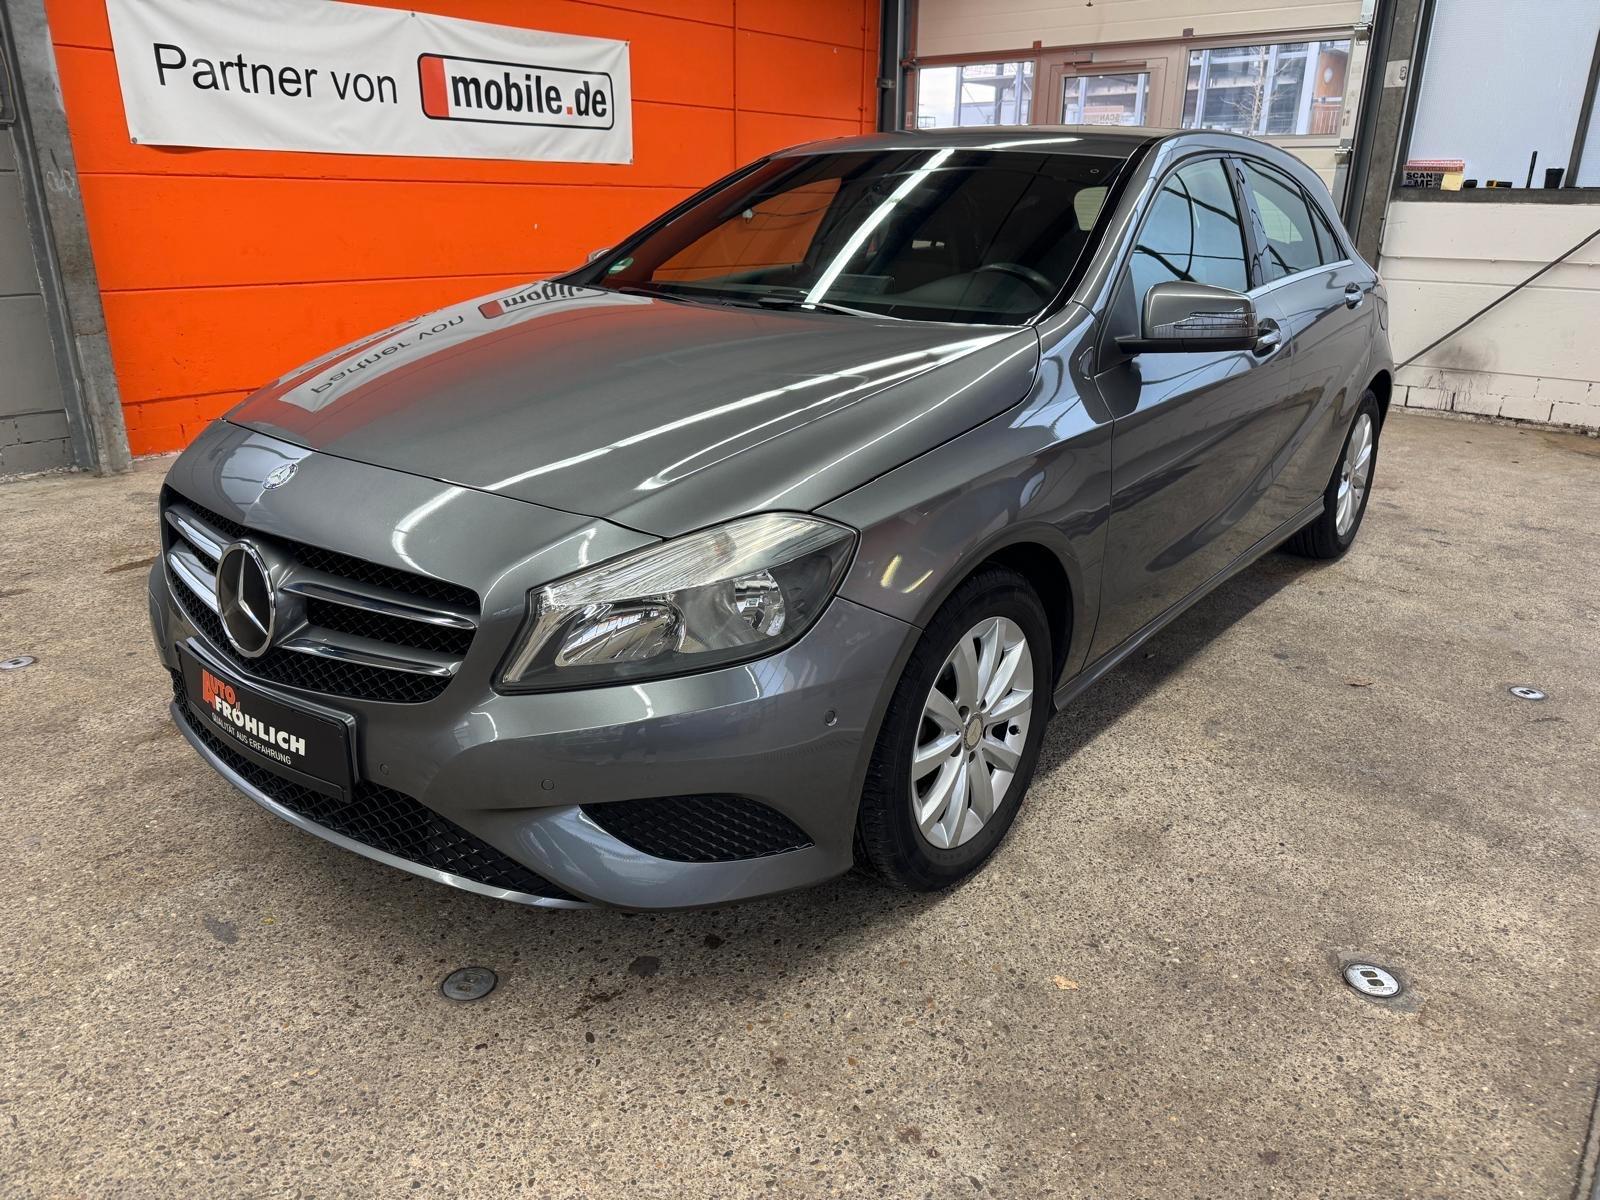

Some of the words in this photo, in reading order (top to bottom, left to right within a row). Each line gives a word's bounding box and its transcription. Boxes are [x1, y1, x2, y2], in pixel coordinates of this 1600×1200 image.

[153, 43, 318, 98] Partner
[331, 70, 398, 104] von
[451, 72, 608, 118] mobile.de
[202, 669, 236, 710] AUTO
[211, 712, 235, 736] QUALITÄT
[236, 730, 249, 744] AUS
[249, 738, 292, 765] ERFAHRUNG
[215, 695, 306, 757] FRÖHLICH
